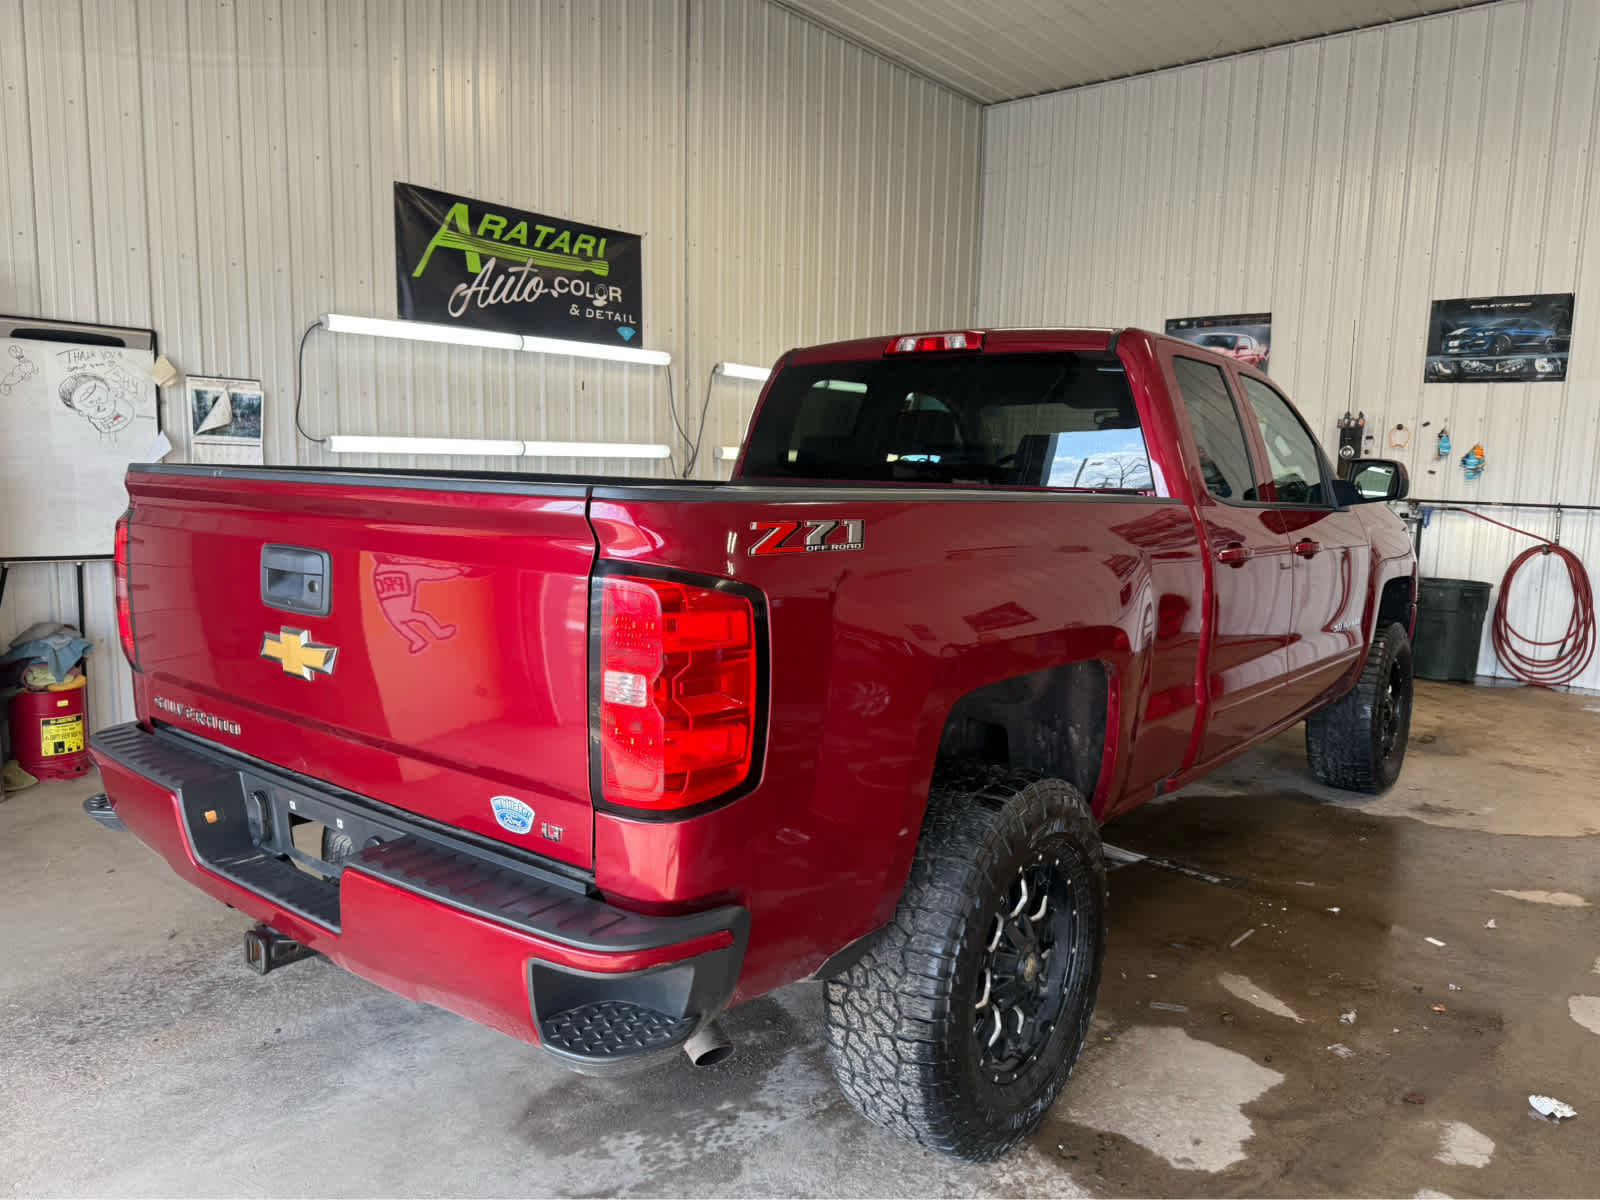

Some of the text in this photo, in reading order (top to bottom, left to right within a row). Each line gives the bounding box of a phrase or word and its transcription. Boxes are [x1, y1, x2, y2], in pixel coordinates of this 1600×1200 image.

[412, 203, 607, 278] ARATARI
[448, 257, 623, 317] Auto COLOR
[569, 304, 637, 325] & DETAIL
[748, 519, 865, 556] Z71
[831, 543, 863, 551] ROAD
[154, 696, 241, 737] SILVERADO
[541, 822, 564, 843] LT
